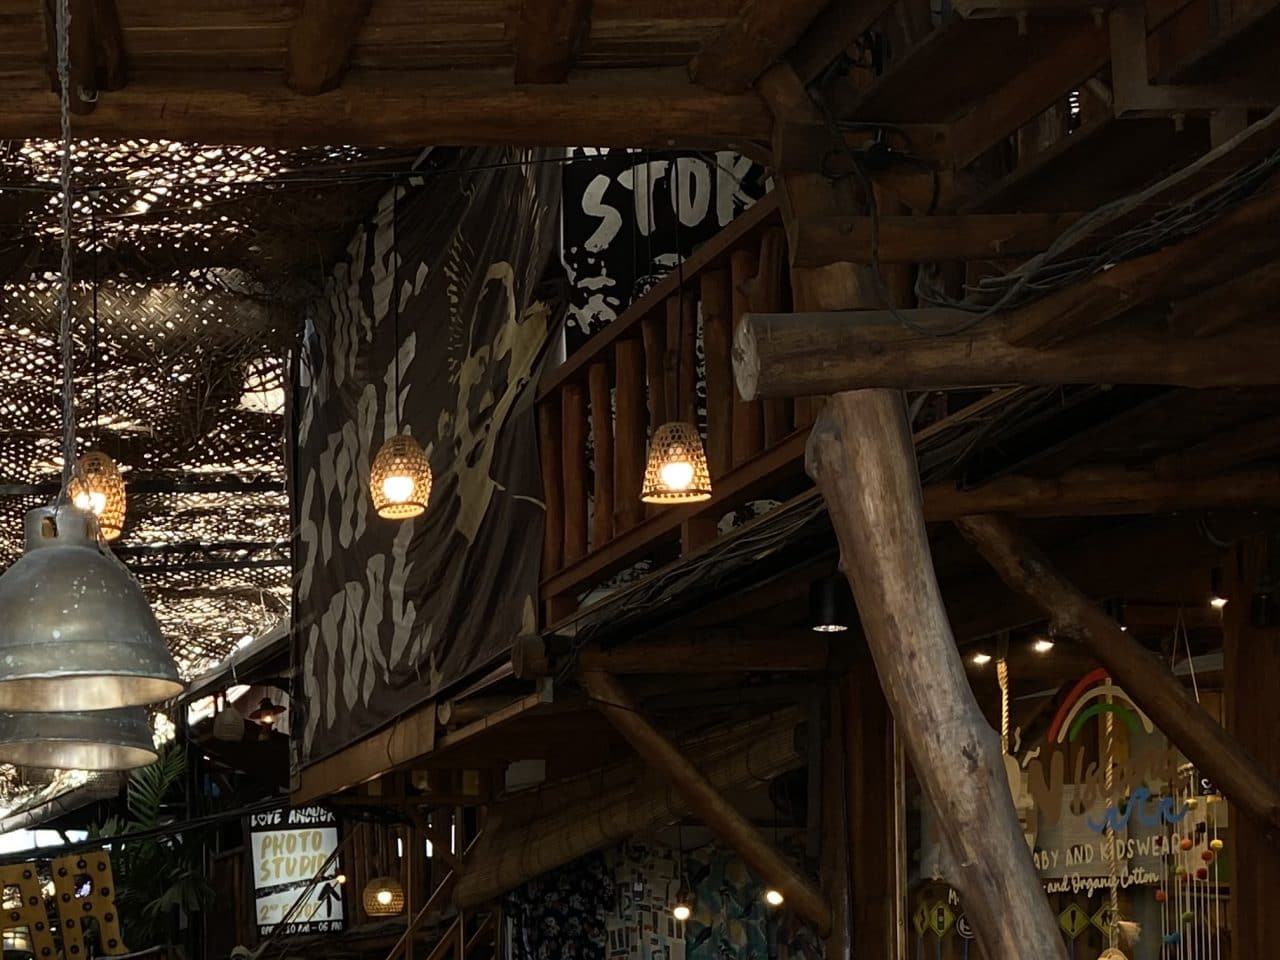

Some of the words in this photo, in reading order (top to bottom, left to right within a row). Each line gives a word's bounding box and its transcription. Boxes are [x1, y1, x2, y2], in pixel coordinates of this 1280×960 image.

[261, 830, 322, 860] PHOTO
[1066, 842, 1094, 867] AND
[1120, 865, 1160, 889] Cotton
